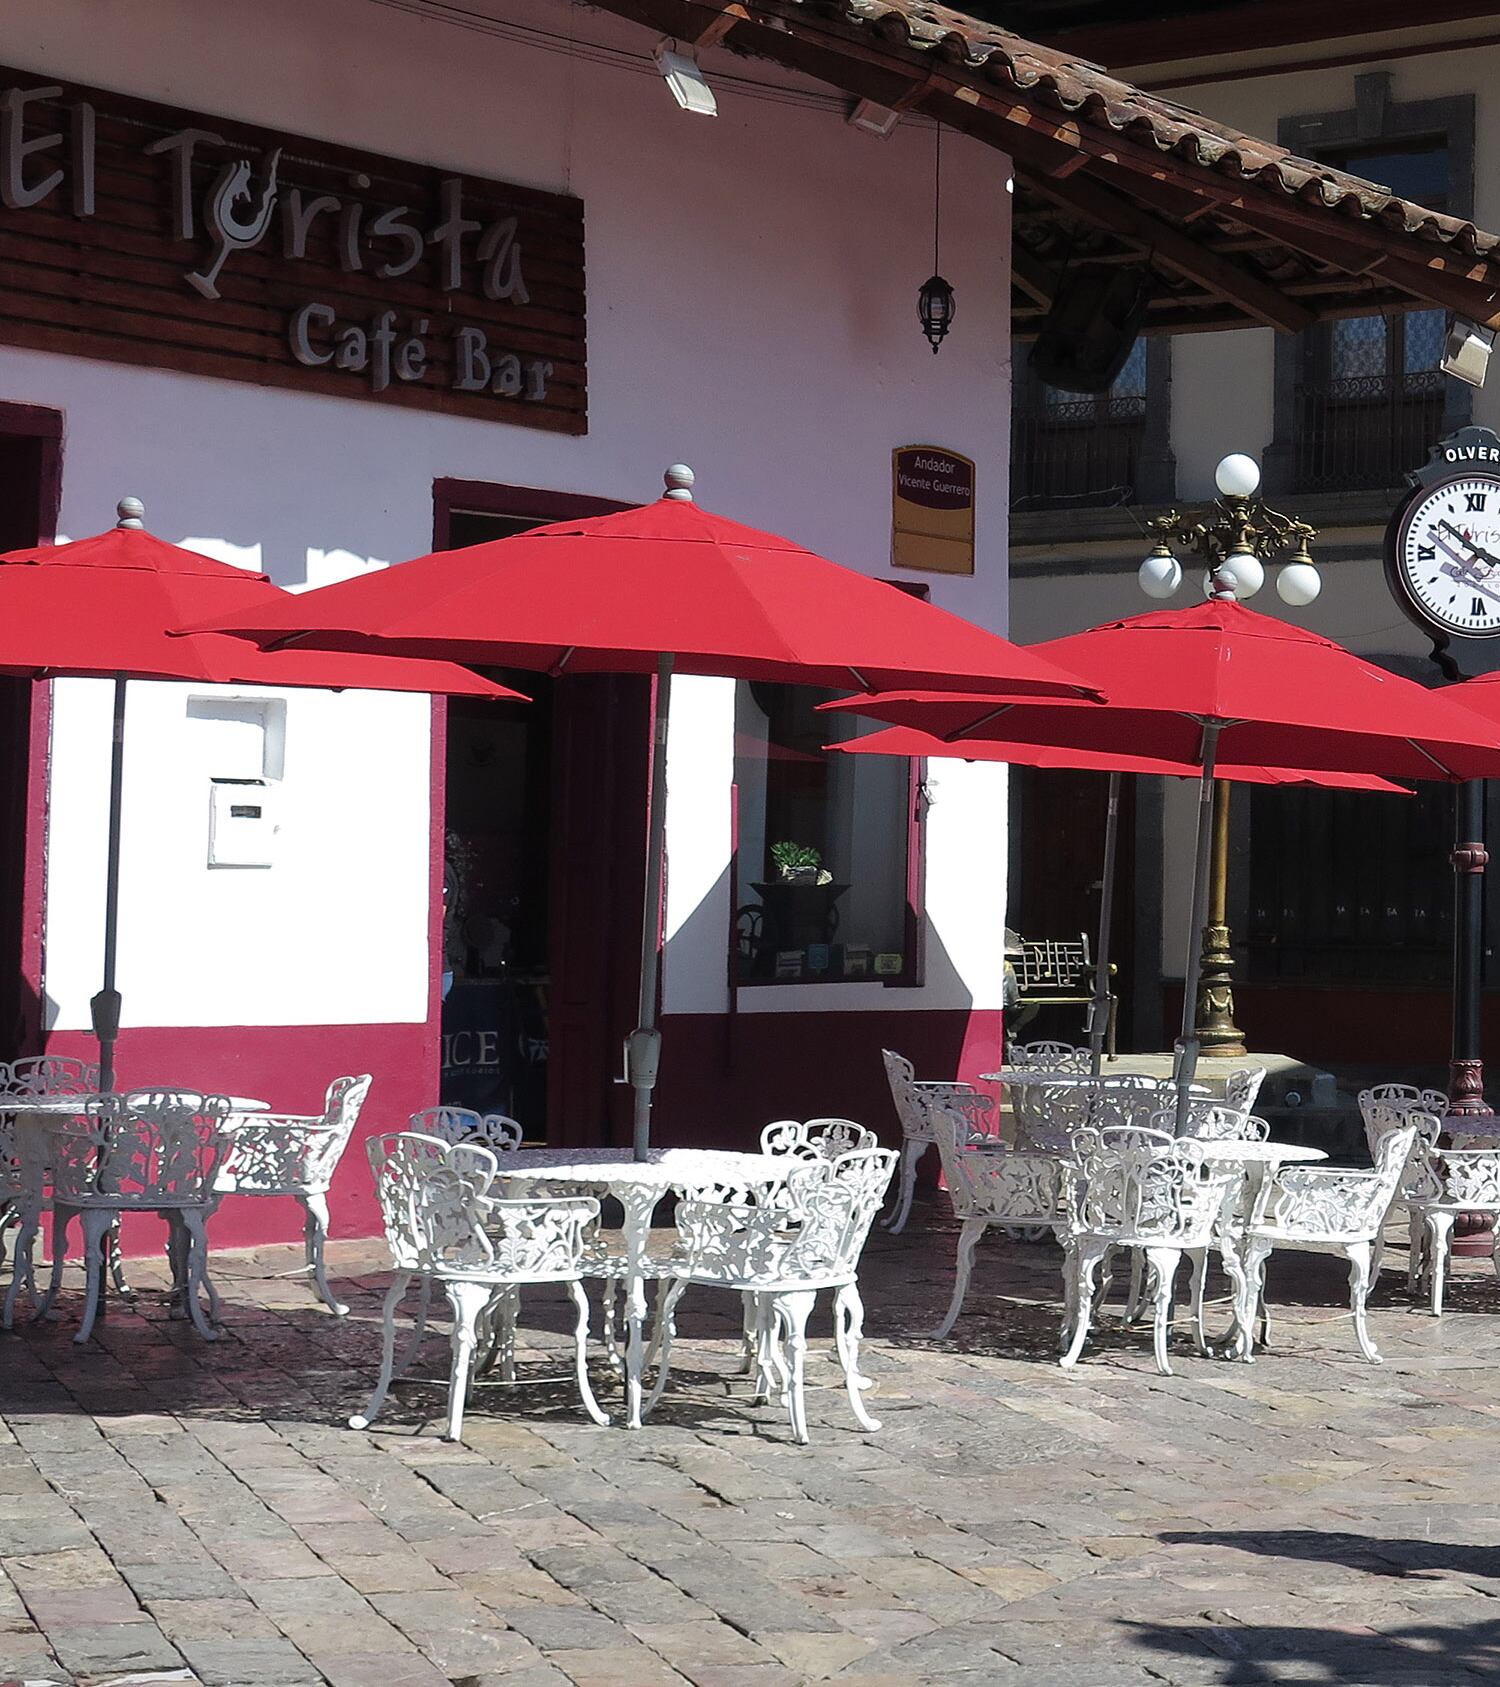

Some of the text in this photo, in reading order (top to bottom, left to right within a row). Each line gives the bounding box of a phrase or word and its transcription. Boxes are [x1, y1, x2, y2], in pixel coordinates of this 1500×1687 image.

[2, 85, 97, 217] El
[289, 302, 554, 401] Café Bar
[914, 455, 956, 475] Andador
[898, 473, 971, 497] Vicente Guerrero
[1464, 493, 1487, 512] XII
